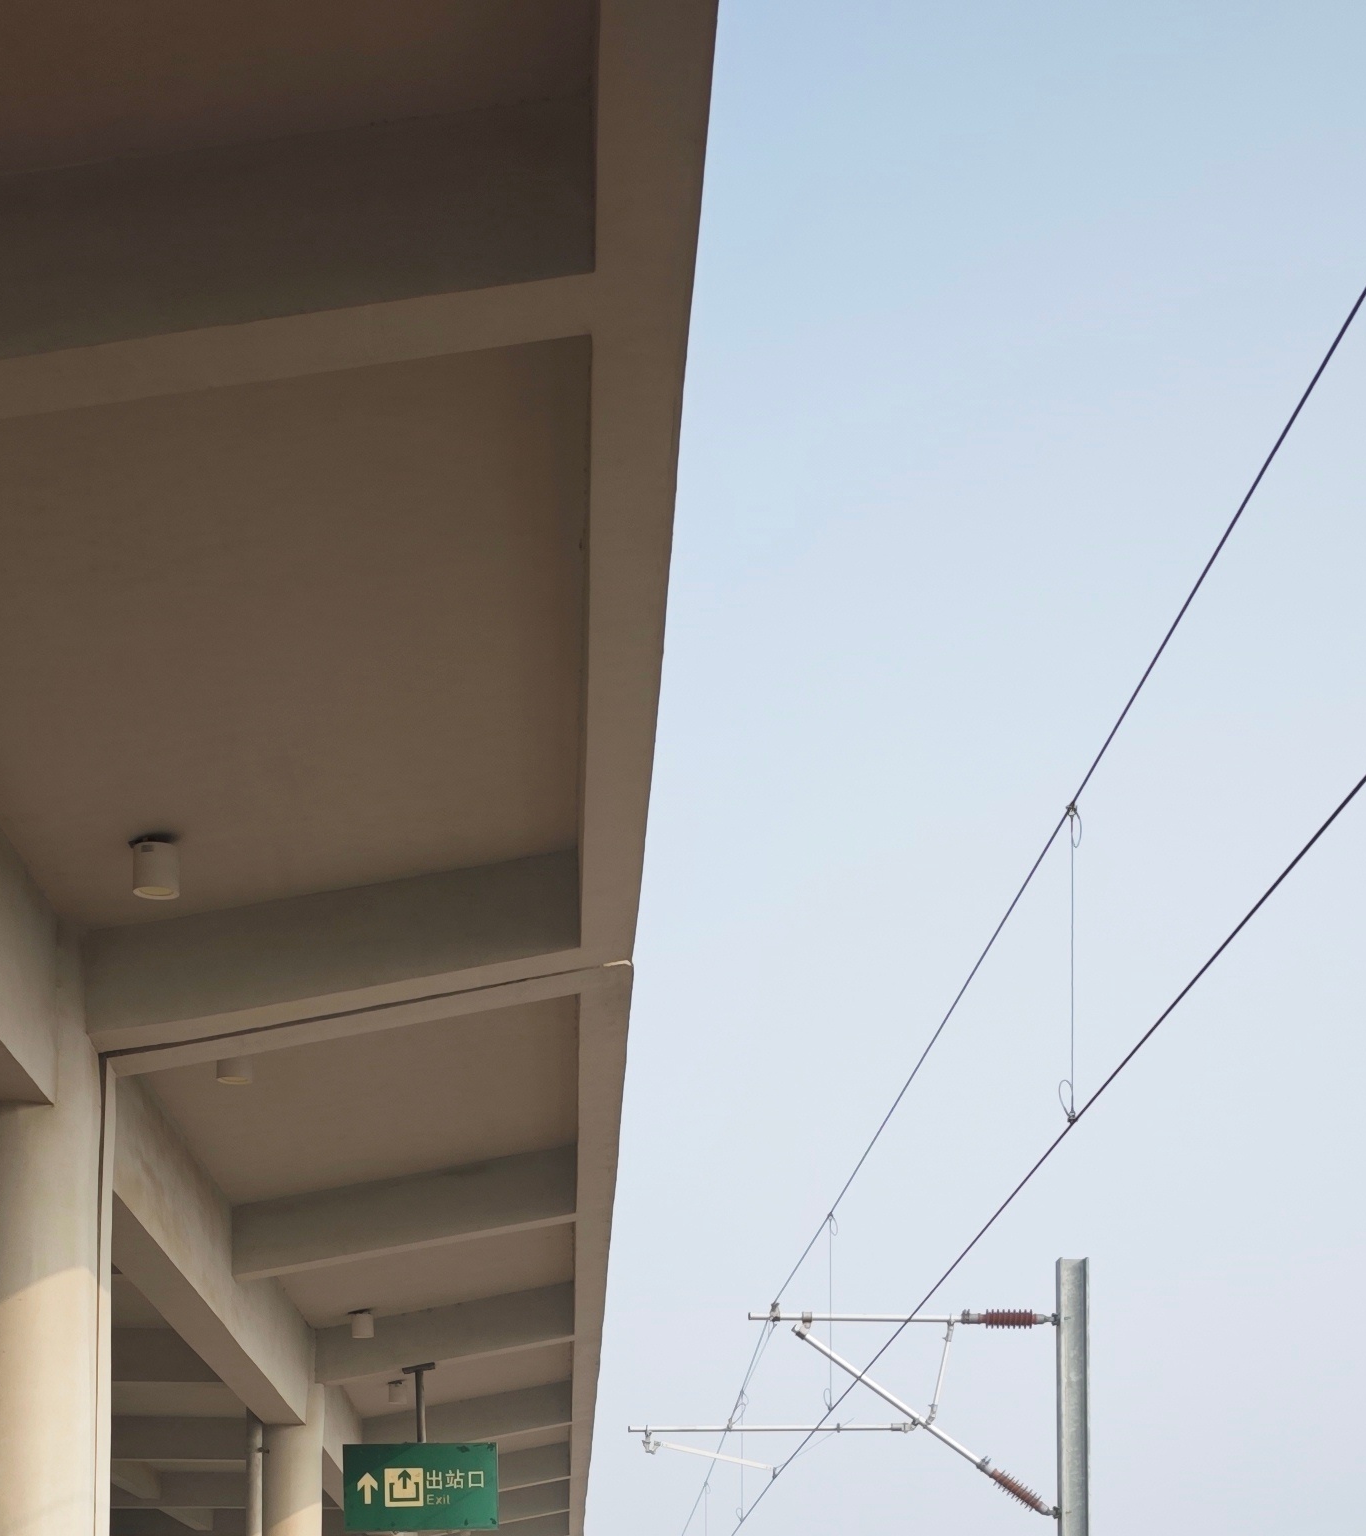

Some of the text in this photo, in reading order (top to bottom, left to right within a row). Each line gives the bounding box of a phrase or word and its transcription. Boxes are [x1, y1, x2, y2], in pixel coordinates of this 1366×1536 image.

[426, 1469, 484, 1490] 出站口
[426, 1494, 450, 1505] Exit
